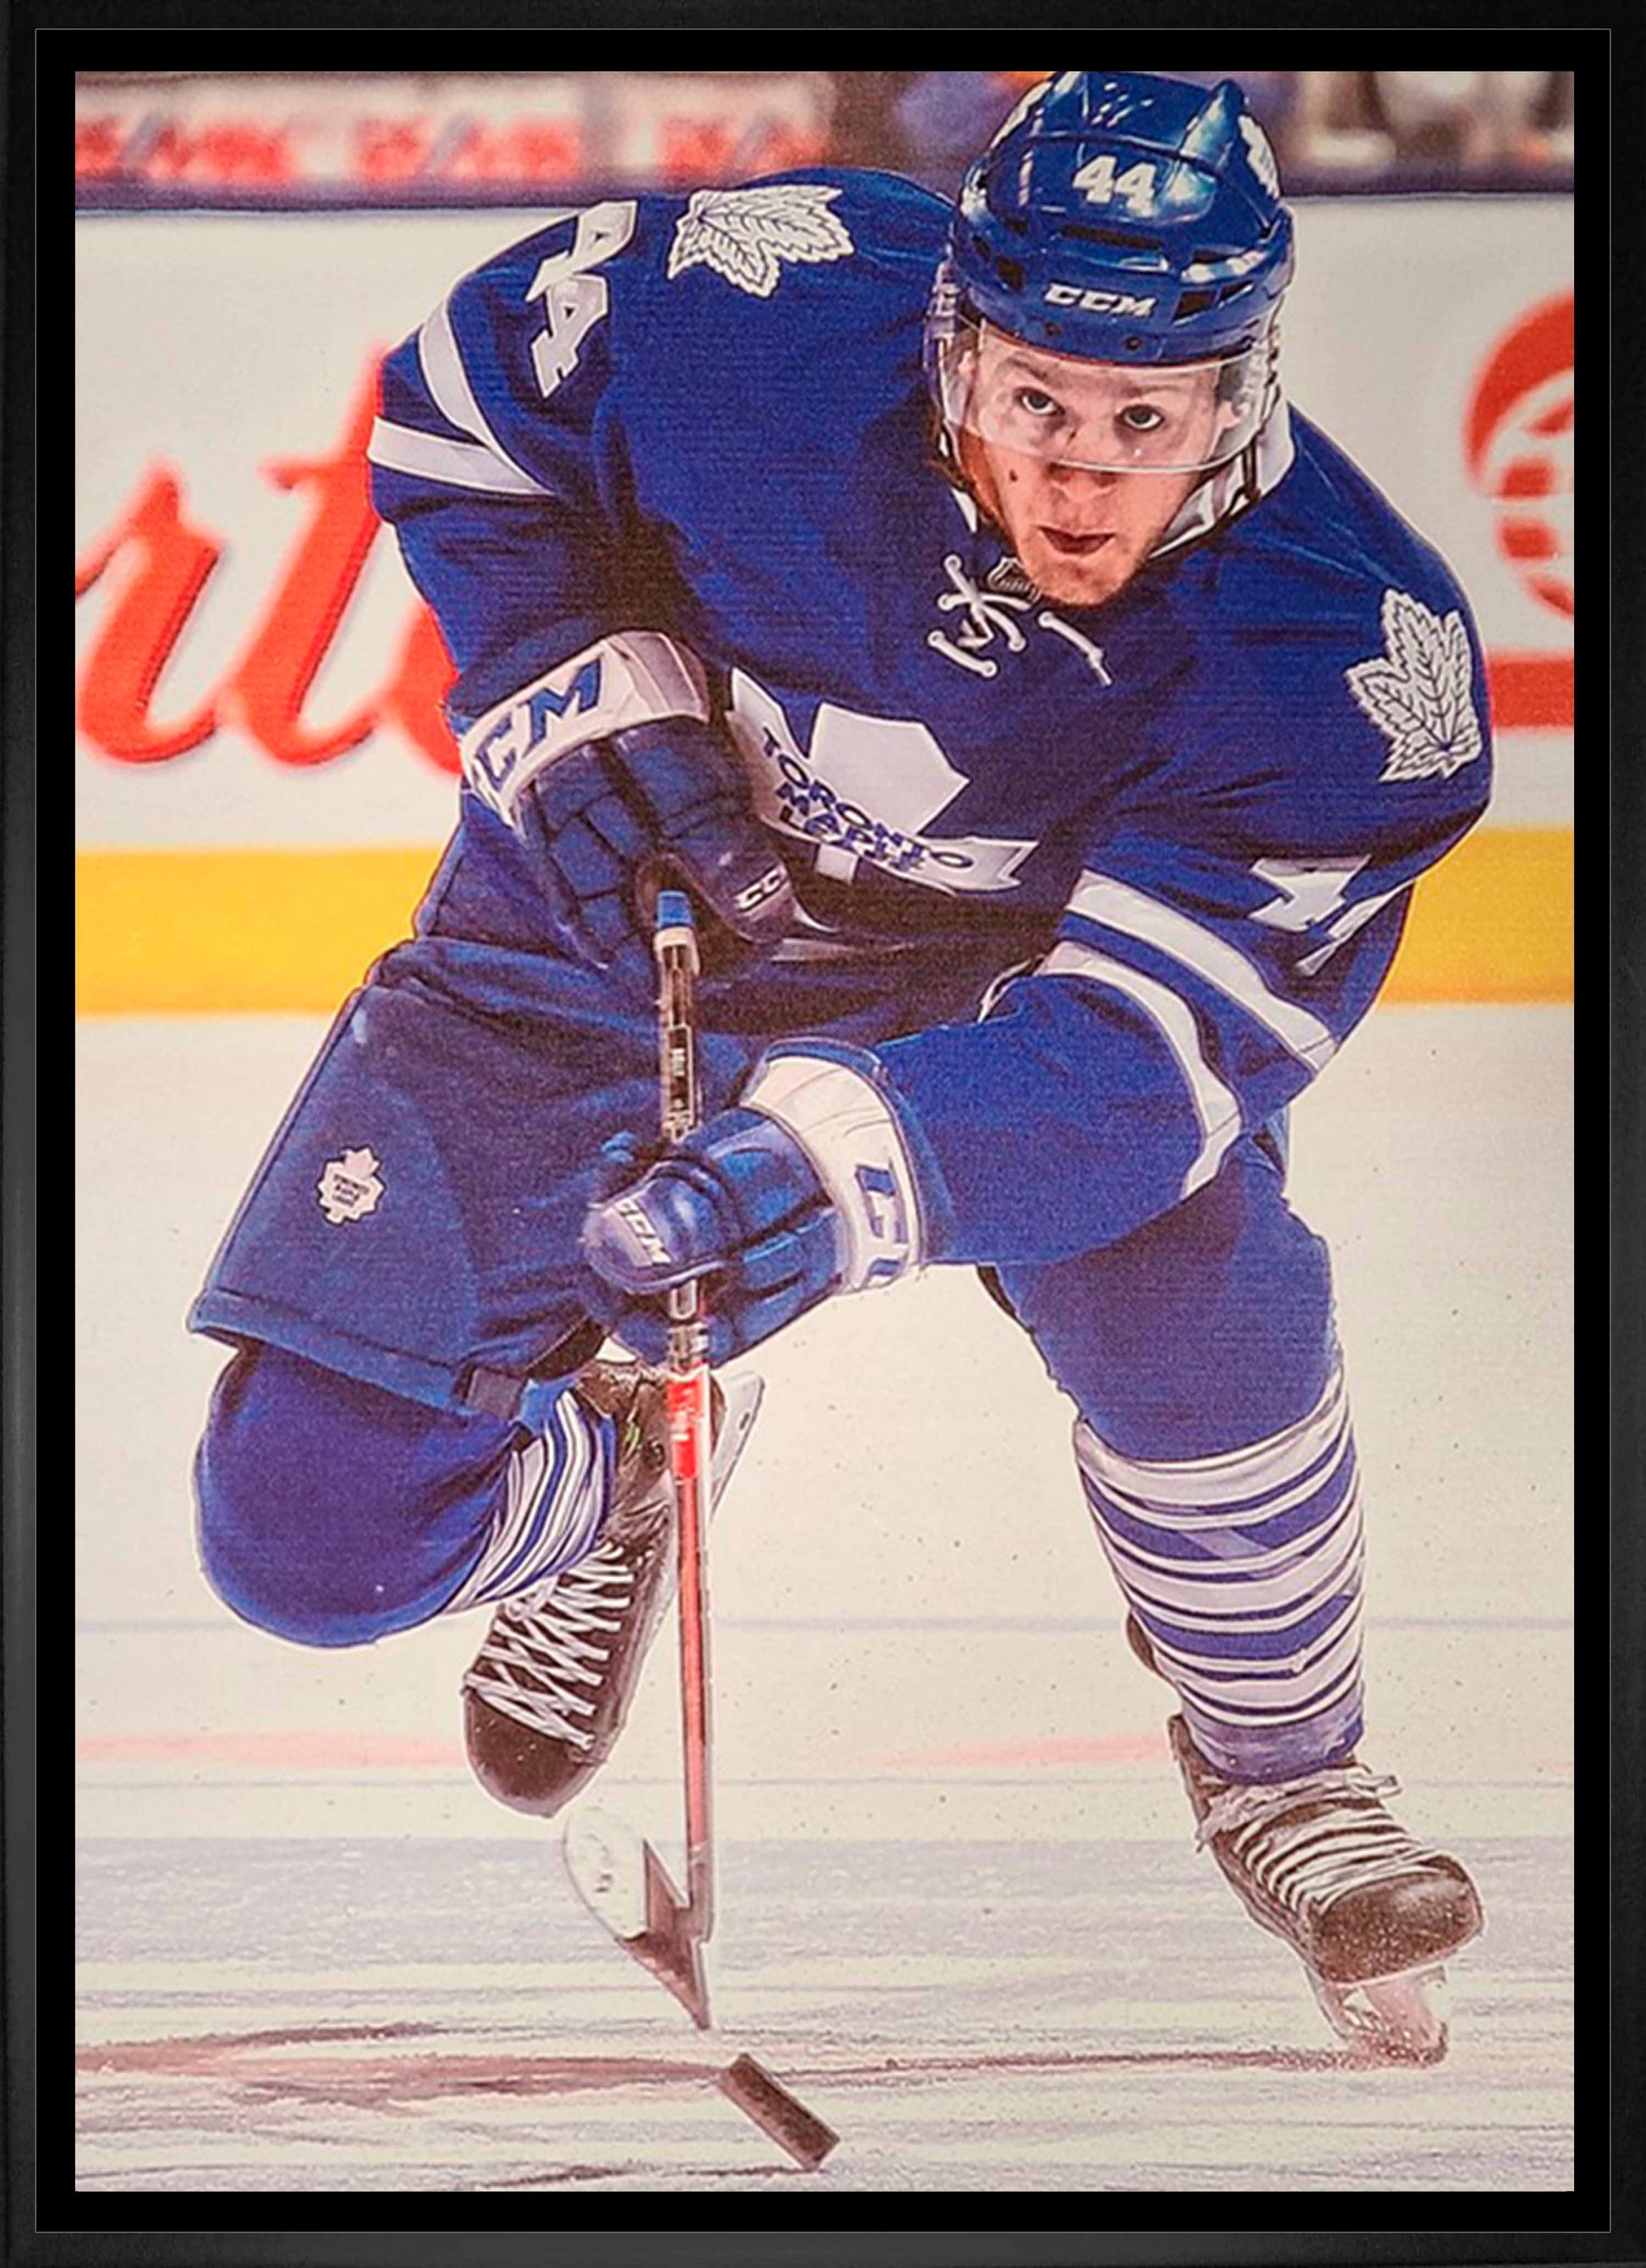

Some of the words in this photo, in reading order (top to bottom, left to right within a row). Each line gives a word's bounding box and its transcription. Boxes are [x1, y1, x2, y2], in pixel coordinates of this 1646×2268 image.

[1073, 155, 1156, 217] 44
[524, 200, 637, 398] 44
[1044, 282, 1156, 316] CCM
[471, 656, 601, 807] CM
[734, 864, 787, 911] CC
